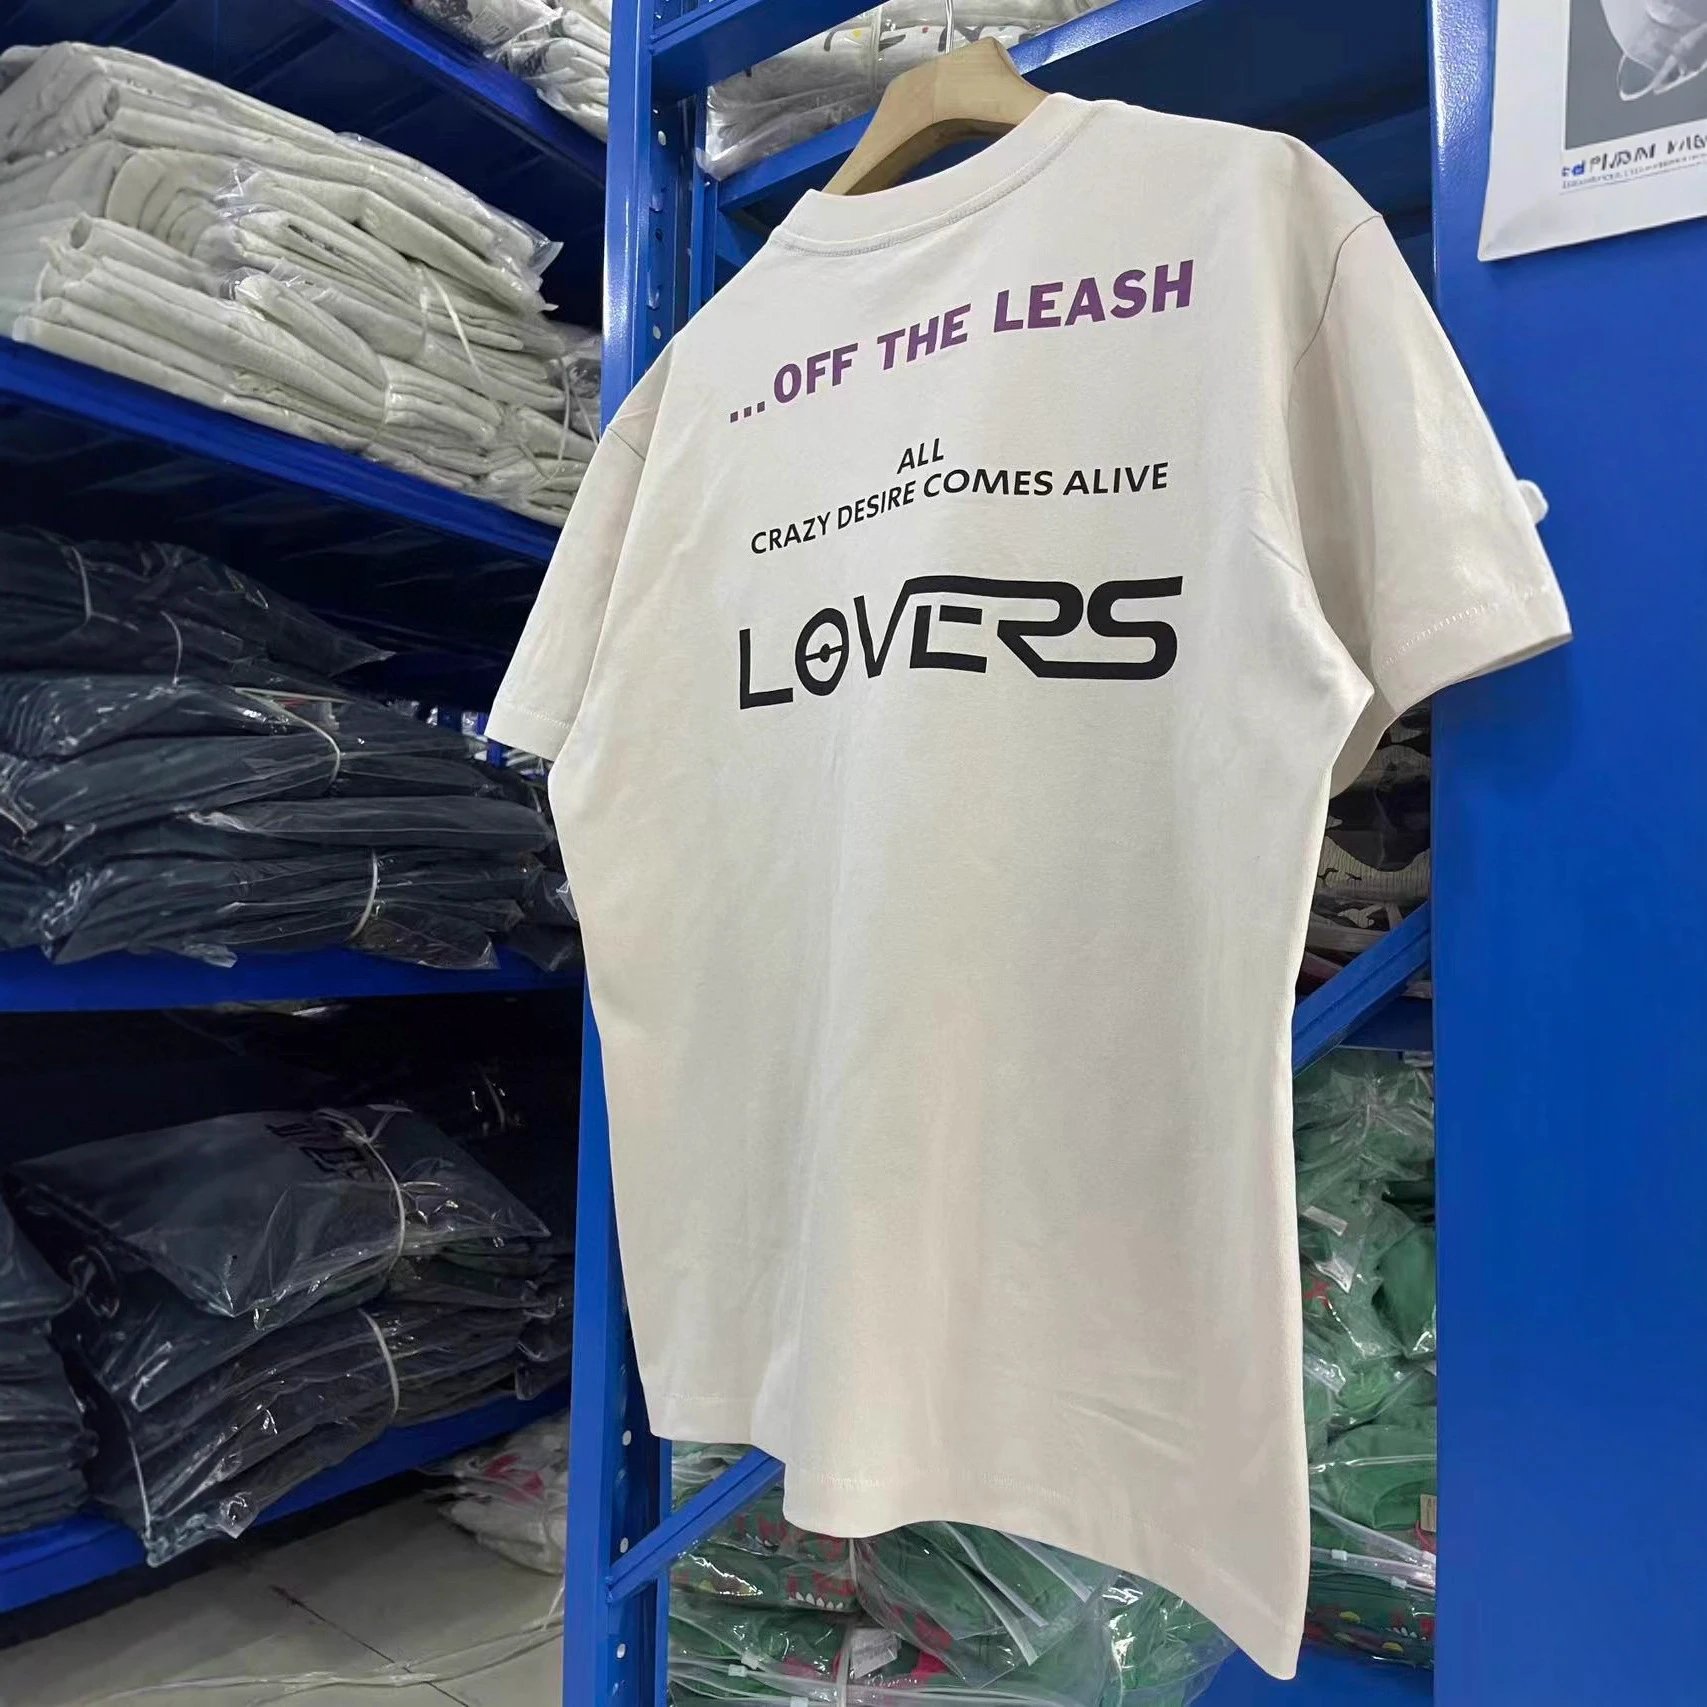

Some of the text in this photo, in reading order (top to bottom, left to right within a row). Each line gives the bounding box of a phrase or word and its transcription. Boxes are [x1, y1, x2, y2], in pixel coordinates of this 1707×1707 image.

[876, 303, 972, 371] THE
[993, 259, 1194, 333] LEASH
[896, 437, 945, 475] ALL
[751, 461, 1169, 555] CRAZY DESIRE COMES ALIVE
[738, 574, 1184, 711] LOVERS
